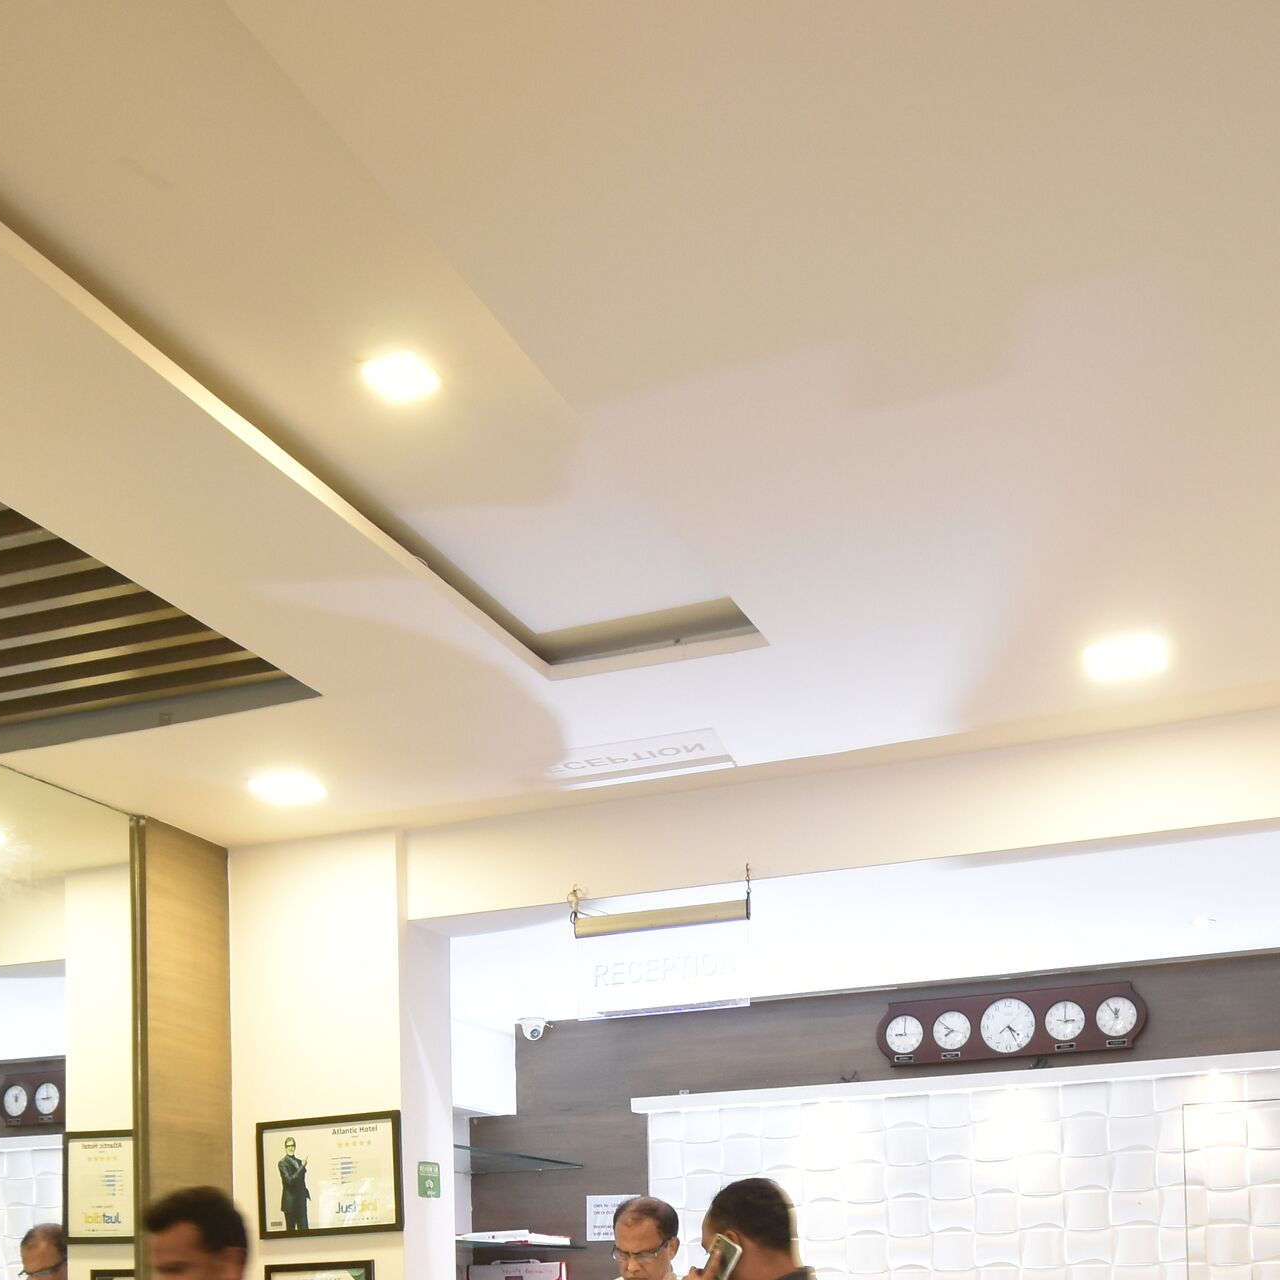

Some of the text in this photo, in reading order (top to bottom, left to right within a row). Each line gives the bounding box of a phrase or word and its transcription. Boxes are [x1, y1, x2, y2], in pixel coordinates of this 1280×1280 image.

[593, 951, 737, 987] RECEPTION
[331, 1124, 378, 1135] Atlantic Hotel
